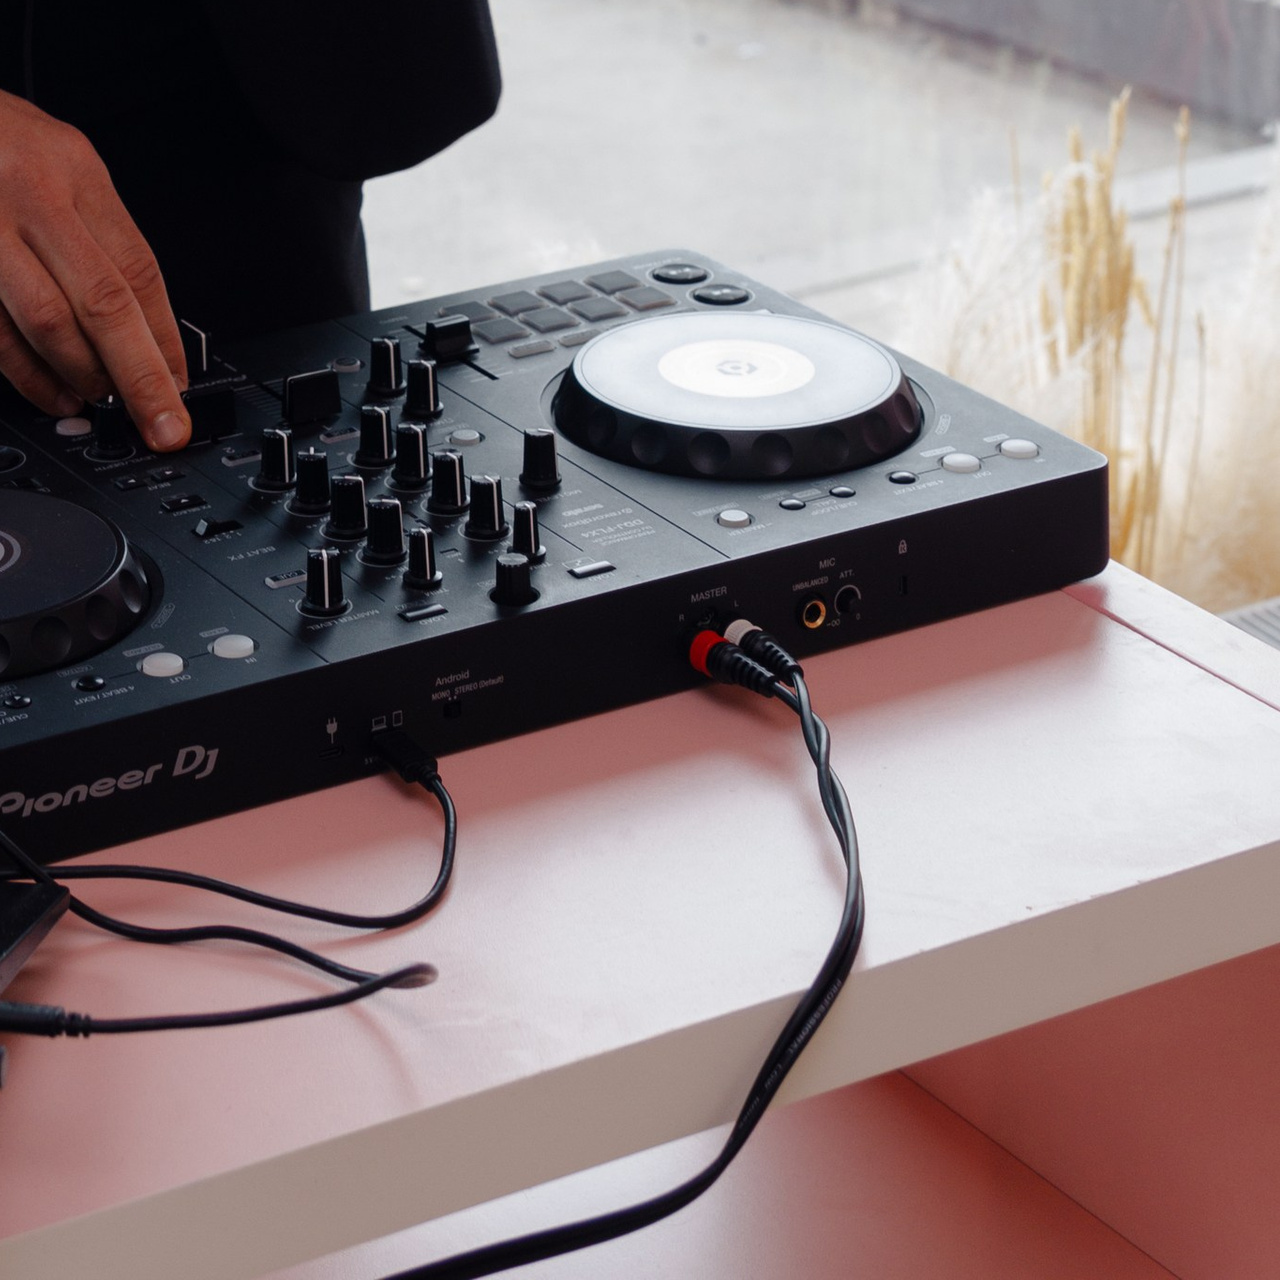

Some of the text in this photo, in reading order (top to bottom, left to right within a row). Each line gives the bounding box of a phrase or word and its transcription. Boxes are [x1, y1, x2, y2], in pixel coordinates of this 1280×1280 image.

[562, 503, 604, 517] serato
[562, 510, 621, 528] rekordbox
[581, 518, 644, 538] DDJ-FLX4
[227, 545, 276, 562] BEAT FX
[819, 558, 836, 570] MIC
[839, 569, 855, 580] ATT.
[792, 576, 829, 592] UNBALANCED
[690, 586, 728, 604] MASTER
[734, 600, 739, 608] L
[305, 609, 380, 631] MASTER LEVEL
[419, 614, 447, 626] LOAD
[678, 614, 685, 622] R
[245, 656, 257, 664] IN
[169, 672, 191, 684] OUT
[435, 668, 470, 687] Android
[431, 674, 505, 701] MONO STEREO (Default)
